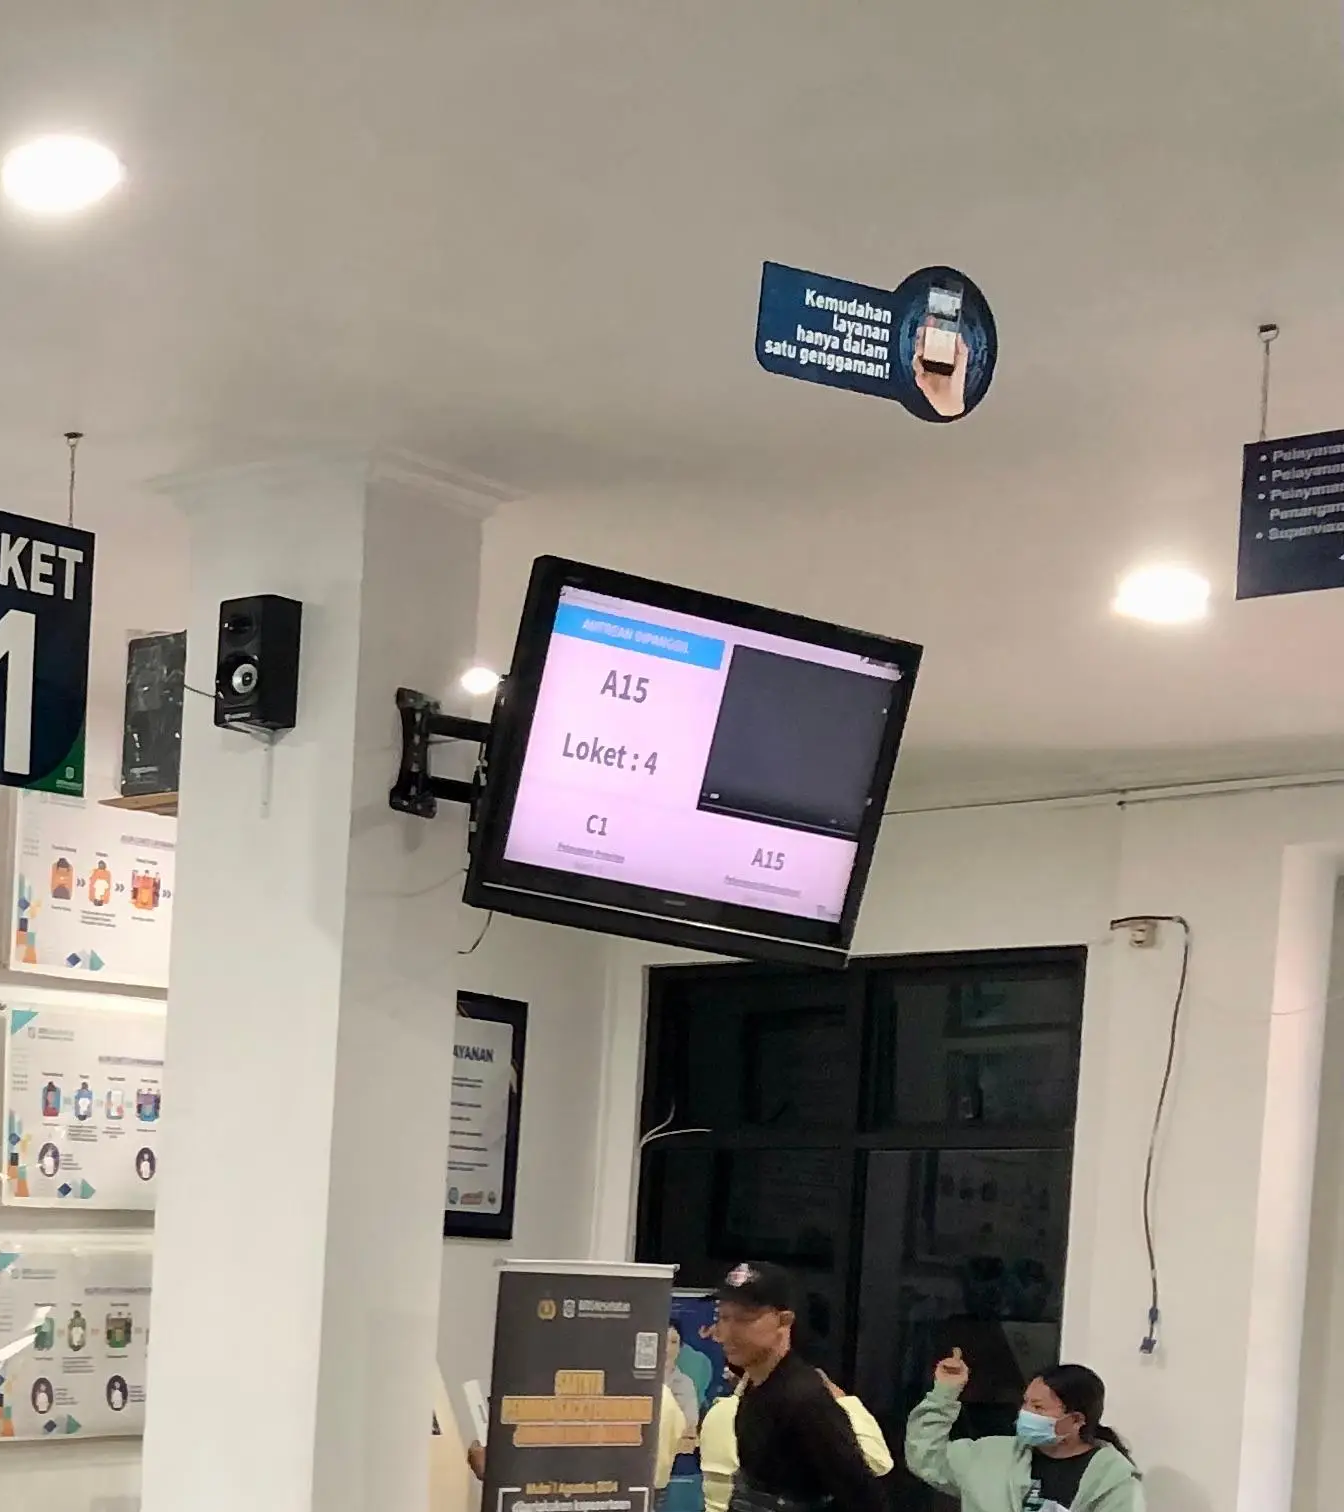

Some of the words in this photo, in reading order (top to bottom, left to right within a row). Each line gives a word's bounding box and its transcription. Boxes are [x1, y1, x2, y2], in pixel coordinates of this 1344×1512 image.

[805, 288, 892, 324] Kemudahan
[797, 324, 840, 351] hanya
[843, 336, 888, 360] dalam
[833, 314, 890, 342] layanan
[765, 340, 797, 359] satu
[800, 347, 891, 380] genggaman!
[600, 670, 650, 704] A15
[586, 814, 609, 836] C1
[751, 848, 786, 871] A15
